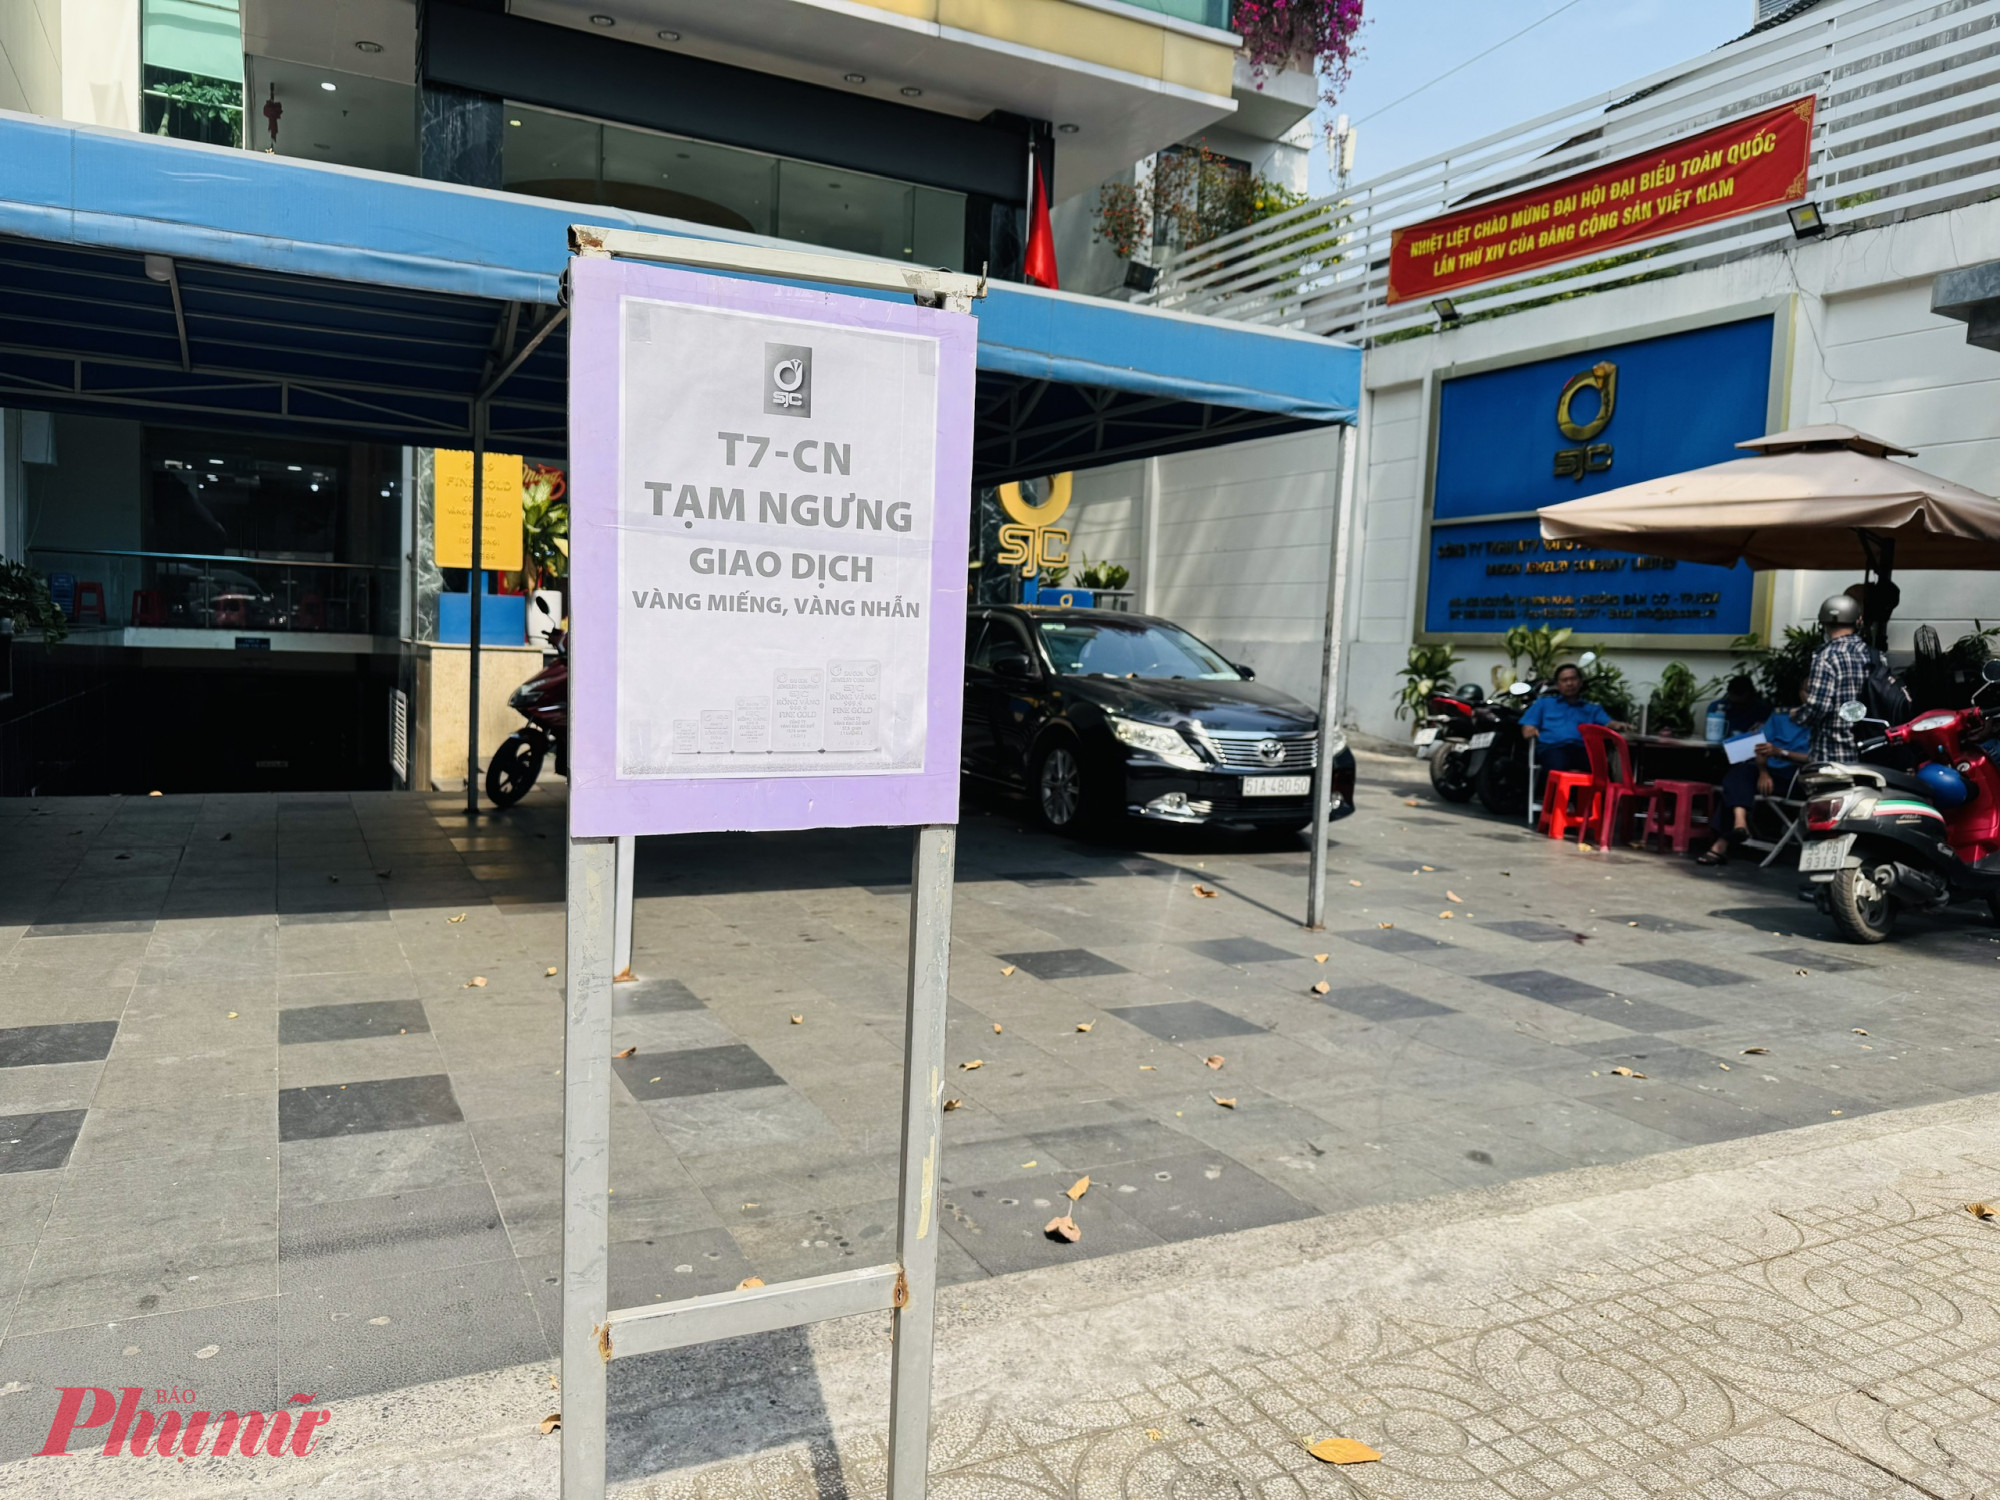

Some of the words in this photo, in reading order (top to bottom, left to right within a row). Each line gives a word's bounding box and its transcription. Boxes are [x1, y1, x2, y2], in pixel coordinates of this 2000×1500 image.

[1410, 233, 1443, 257] NHIỆT
[1446, 225, 1471, 248] LIỆT
[1474, 214, 1508, 240] CHÀO
[1511, 201, 1550, 229] MỪNG
[1553, 195, 1577, 218] ĐẠI
[1580, 183, 1606, 209] HỘI
[1610, 177, 1635, 201] ĐẠI
[1640, 160, 1676, 191] BIỂU
[1681, 150, 1724, 179] TOÀN
[1727, 128, 1777, 165] QUỐC
[1485, 242, 1505, 263] XIV
[1509, 232, 1534, 257] CỦA
[1539, 226, 1575, 248] ĐẢNG
[1579, 211, 1618, 238] CỘNG
[1622, 199, 1652, 225] SẢN
[1656, 189, 1693, 215] VIỆT
[1696, 177, 1734, 204] NAM
[773, 390, 803, 408] SJC
[718, 431, 851, 476] T7-CN
[1553, 443, 1613, 482] SJC
[644, 481, 746, 530] TẠM
[759, 491, 913, 533] NGƯNG
[689, 547, 782, 578] GIAO
[792, 553, 874, 589] DỊCH
[997, 523, 1071, 578] SJC
[632, 588, 701, 613] VÀNG
[708, 589, 788, 616] MIẾNG,
[794, 594, 856, 617] VÀNG
[861, 593, 921, 619] NHẪN
